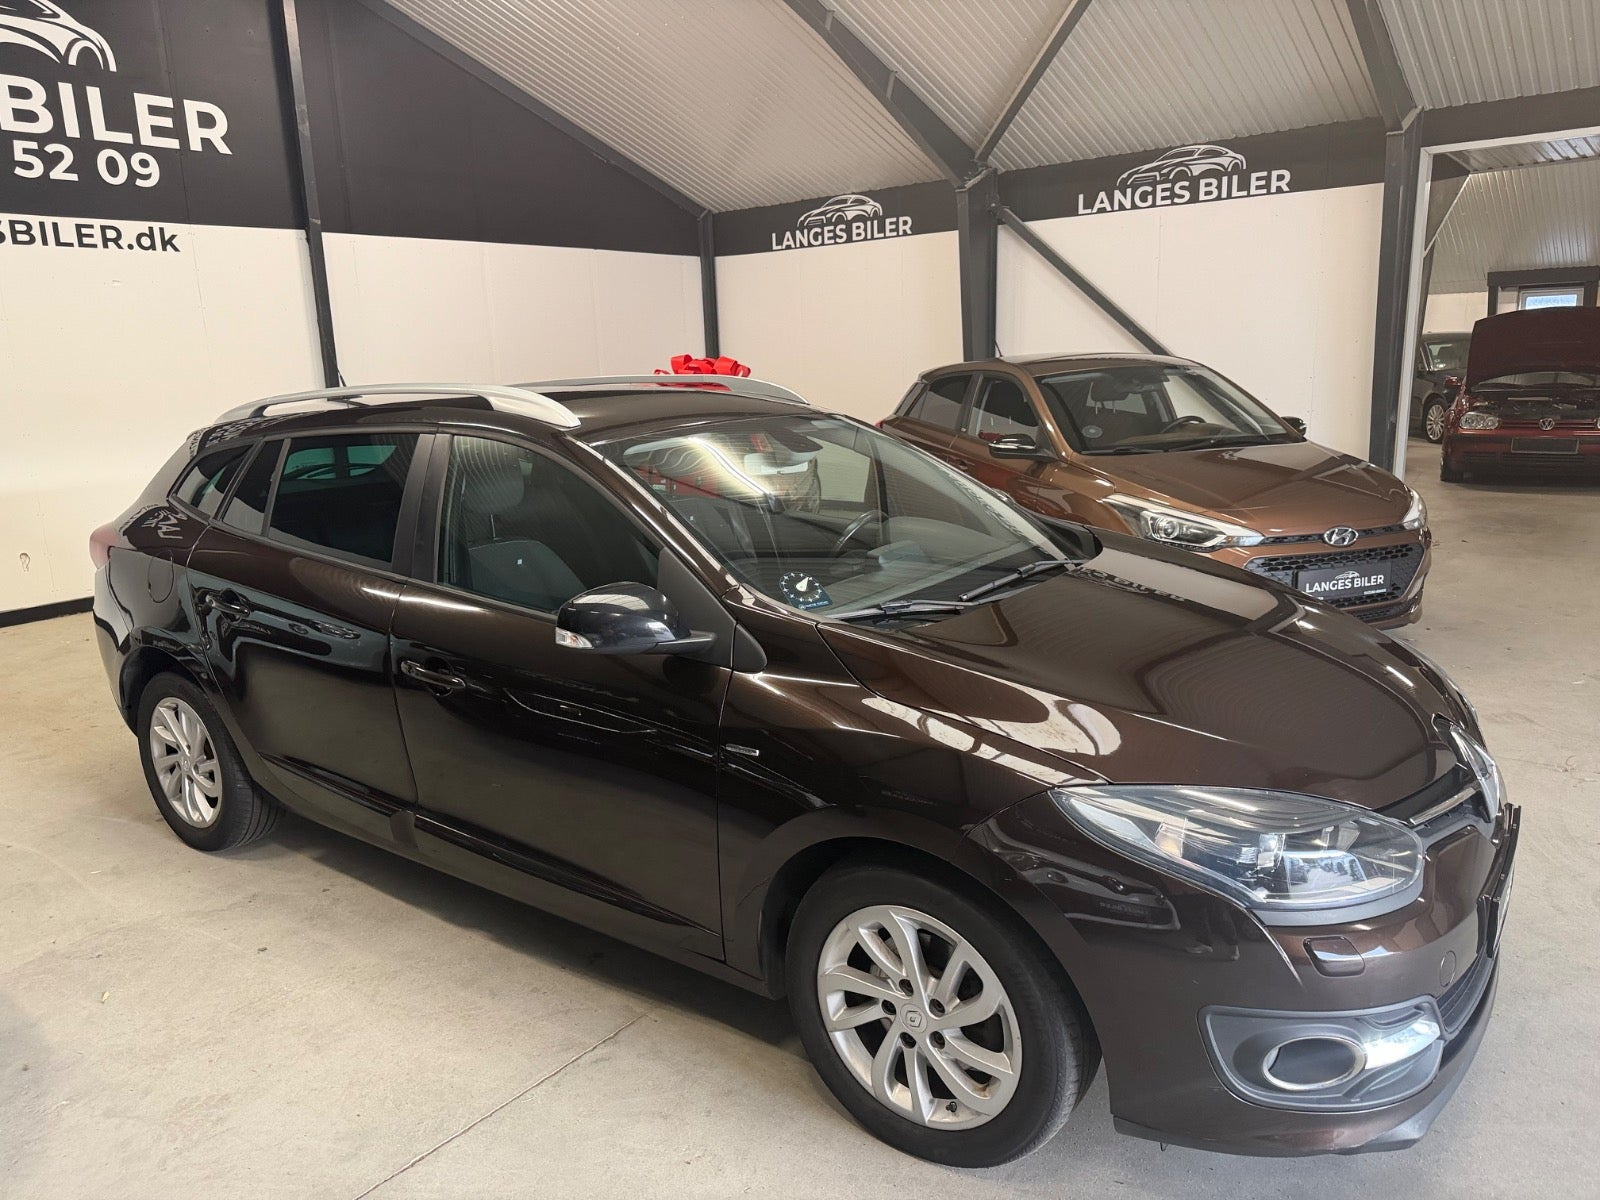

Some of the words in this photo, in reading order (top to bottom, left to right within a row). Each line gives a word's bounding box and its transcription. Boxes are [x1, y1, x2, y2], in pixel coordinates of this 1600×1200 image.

[0, 73, 232, 155] BILER
[13, 139, 79, 182] 52
[96, 148, 160, 188] 09
[1078, 180, 1191, 215] LANGES
[1199, 169, 1291, 200] BILER
[0, 219, 181, 252] BILER.dk
[771, 224, 847, 251] LANGES
[852, 216, 913, 241] BILER
[1305, 578, 1352, 593] LANGES
[1353, 574, 1385, 588] BILER
